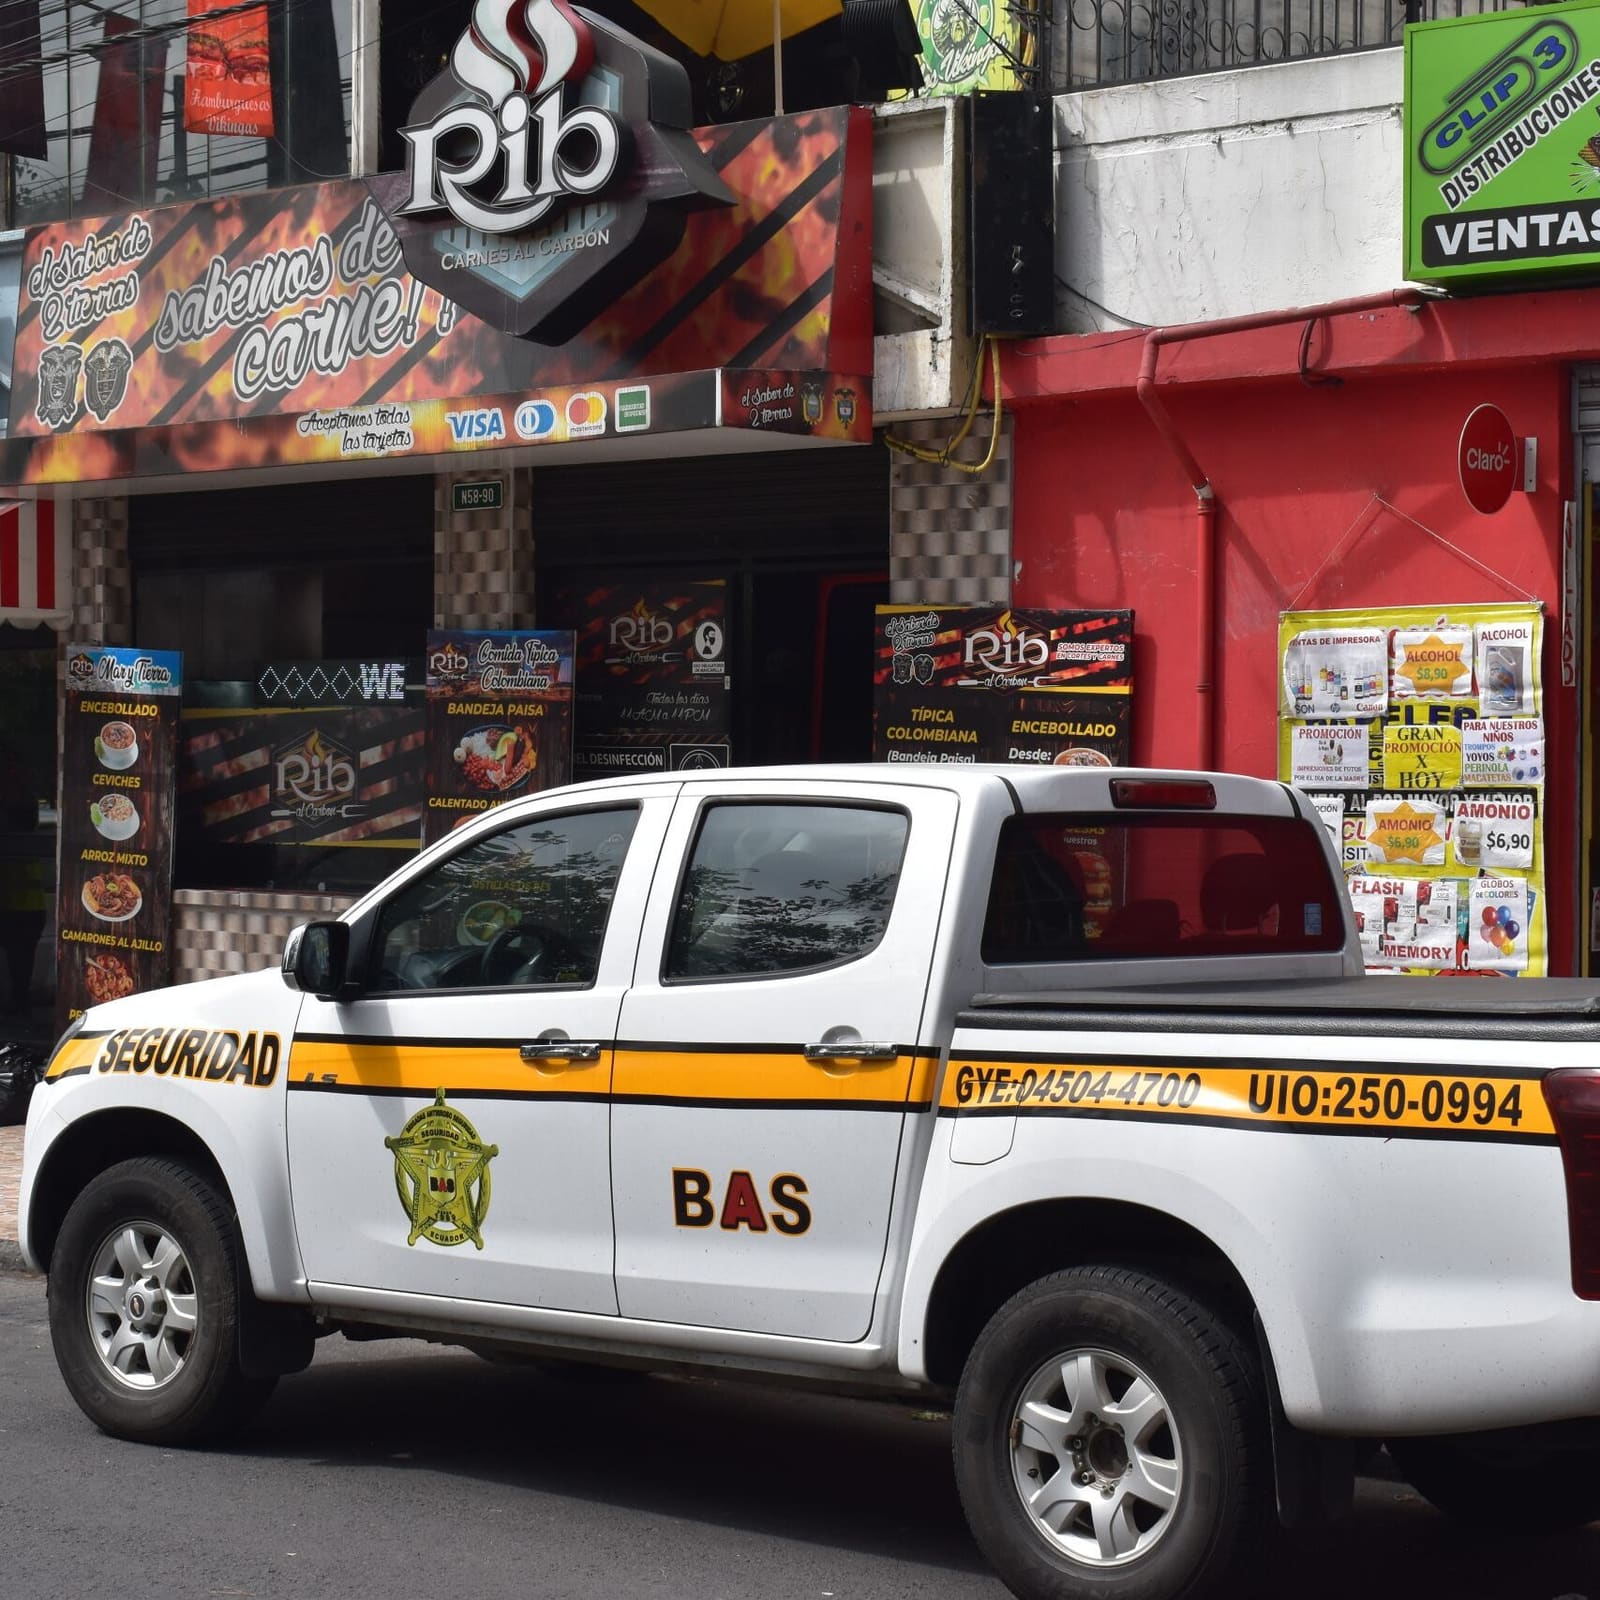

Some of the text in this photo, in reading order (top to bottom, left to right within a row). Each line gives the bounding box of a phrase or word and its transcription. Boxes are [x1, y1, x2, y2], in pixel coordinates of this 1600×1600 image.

[1436, 35, 1566, 149] CLIP 3
[1440, 60, 1600, 210] DISTRIBUCIONES
[392, 82, 619, 233] Rib
[121, 214, 152, 261] de
[1434, 210, 1600, 256] VENTAS
[440, 228, 611, 271] CARNES AL CARBÓN
[155, 196, 402, 352] sabemos de
[42, 271, 139, 342] 2 tierras
[783, 383, 794, 399] de
[297, 406, 412, 436] Aceptamos todas
[447, 412, 504, 438] VISA
[751, 407, 792, 428] 2 tierras
[341, 428, 412, 455] las tarjetas
[1466, 447, 1504, 472] Claro
[461, 489, 494, 505] N58-90
[609, 616, 673, 651] Rib
[1319, 637, 1331, 645] DE
[1333, 636, 1381, 645] IMPRESORA
[1481, 629, 1529, 641] ALCOHOL
[478, 639, 524, 664] Comida
[964, 631, 1049, 672] Rib
[1406, 650, 1461, 662] ALCOHOL
[135, 657, 171, 683] Tierra
[430, 652, 469, 673] Rib
[481, 665, 550, 691] Colombiana
[1416, 667, 1448, 681] $8,90
[80, 701, 158, 716] ENCEBOLLADO
[447, 703, 544, 716] BANDEJA PAISA
[911, 706, 955, 723] TÍPICA
[1011, 720, 1117, 737] ENCEBOLLADO
[1299, 728, 1362, 739] PROMOCIÓN
[1397, 727, 1444, 740] GRAN
[1464, 720, 1538, 731] PARA NUESTROS
[886, 727, 978, 744] COLOMBIANA
[1483, 731, 1514, 742] NIÑOS
[1009, 747, 1052, 761] Desde:
[1384, 741, 1462, 753] PROMOCIÓN
[1464, 743, 1496, 751] TROMPOS
[590, 751, 664, 767] DESINFECCIÓN
[1416, 755, 1427, 769] X
[1466, 752, 1495, 762] YOYOS
[275, 751, 356, 801] Rib
[1464, 763, 1509, 773] PERINOLA
[92, 774, 141, 788] CEVICHES
[1400, 772, 1446, 789] HOY
[429, 797, 488, 809] CALENTADO
[1315, 804, 1338, 812] OCIÓN
[1457, 803, 1531, 819] AMONIO
[1378, 819, 1433, 831] AMONIO
[1387, 836, 1420, 849] $6,90
[1486, 833, 1530, 851] $6,90
[81, 849, 148, 866] ARROZ MIXTO
[1352, 880, 1404, 895] FLASH
[1481, 880, 1514, 888] GLOBOS
[1484, 890, 1519, 898] COLORES
[62, 930, 163, 952] CAMARONES AL AJILLO
[1384, 945, 1453, 960] MEMORY
[98, 1027, 280, 1088] SEGURIDAD
[956, 1065, 1523, 1126] GYE:04504-4700 UIO:250-0994
[421, 1128, 459, 1141] SEGURIDAD
[672, 1167, 812, 1237] BAS
[430, 1231, 464, 1243] ECUADOR
